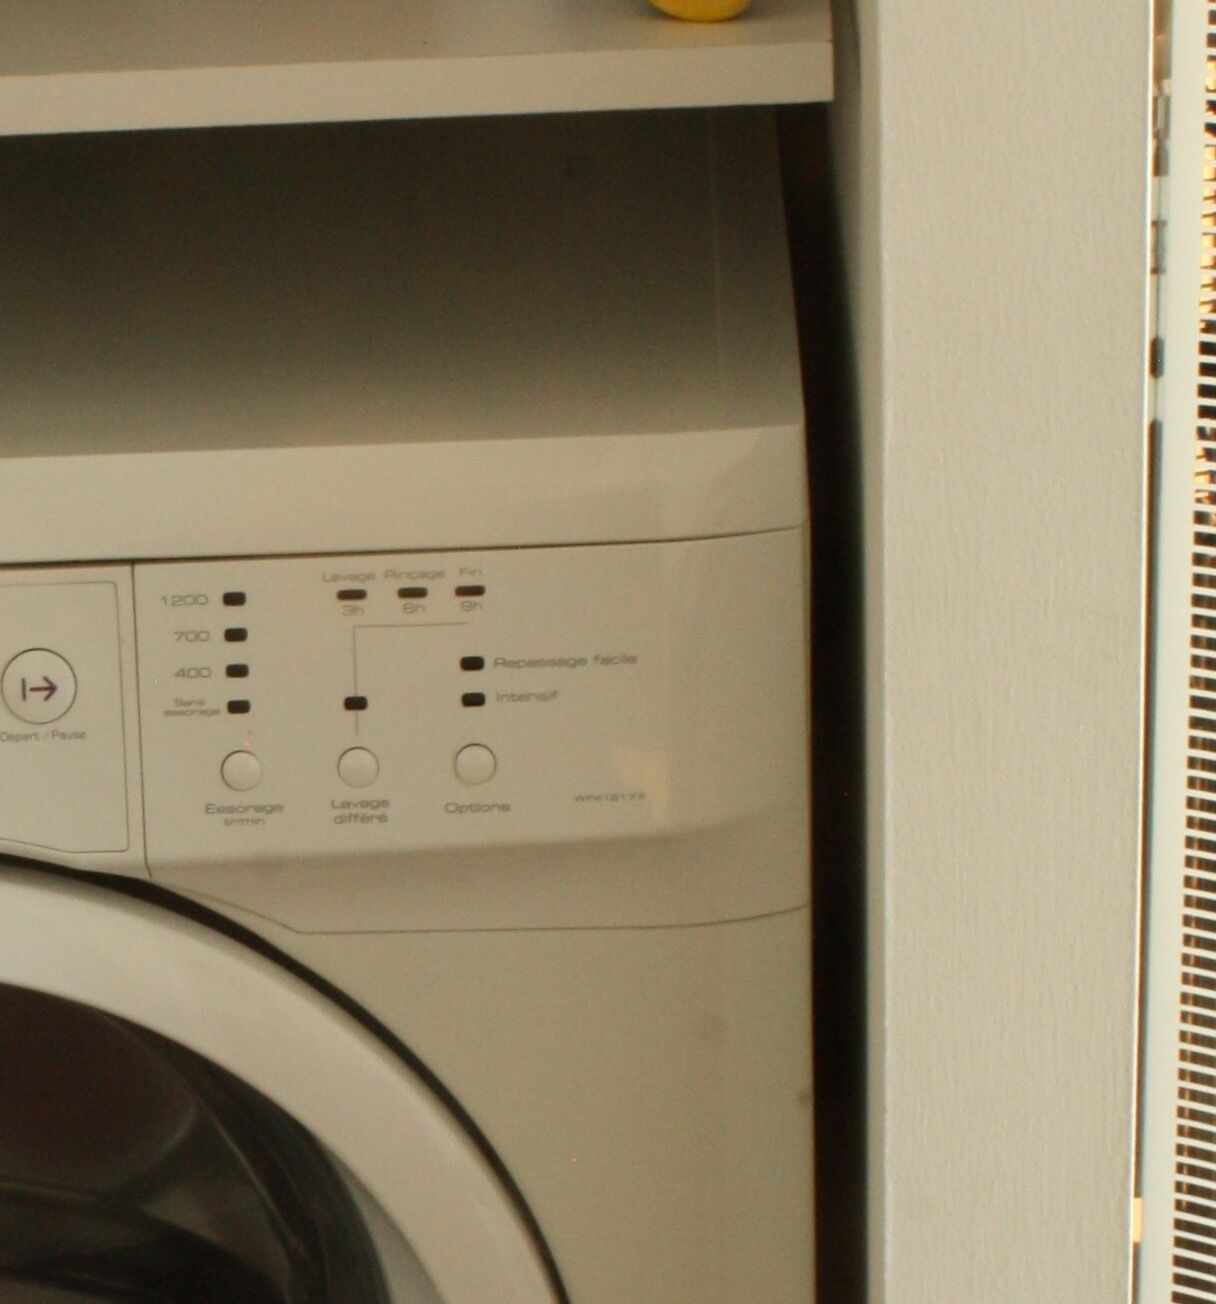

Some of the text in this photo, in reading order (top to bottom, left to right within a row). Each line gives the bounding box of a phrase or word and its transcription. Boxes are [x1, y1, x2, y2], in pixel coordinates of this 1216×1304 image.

[322, 571, 376, 582] Lavage
[160, 594, 209, 606] 1200
[343, 604, 365, 616] 3h
[174, 631, 210, 642] 700
[494, 655, 588, 669] Repassage
[174, 667, 212, 679] 400
[205, 803, 284, 815] Essorage
[331, 798, 390, 809] Lavage
[444, 801, 510, 814] Options
[334, 812, 388, 824] différé
